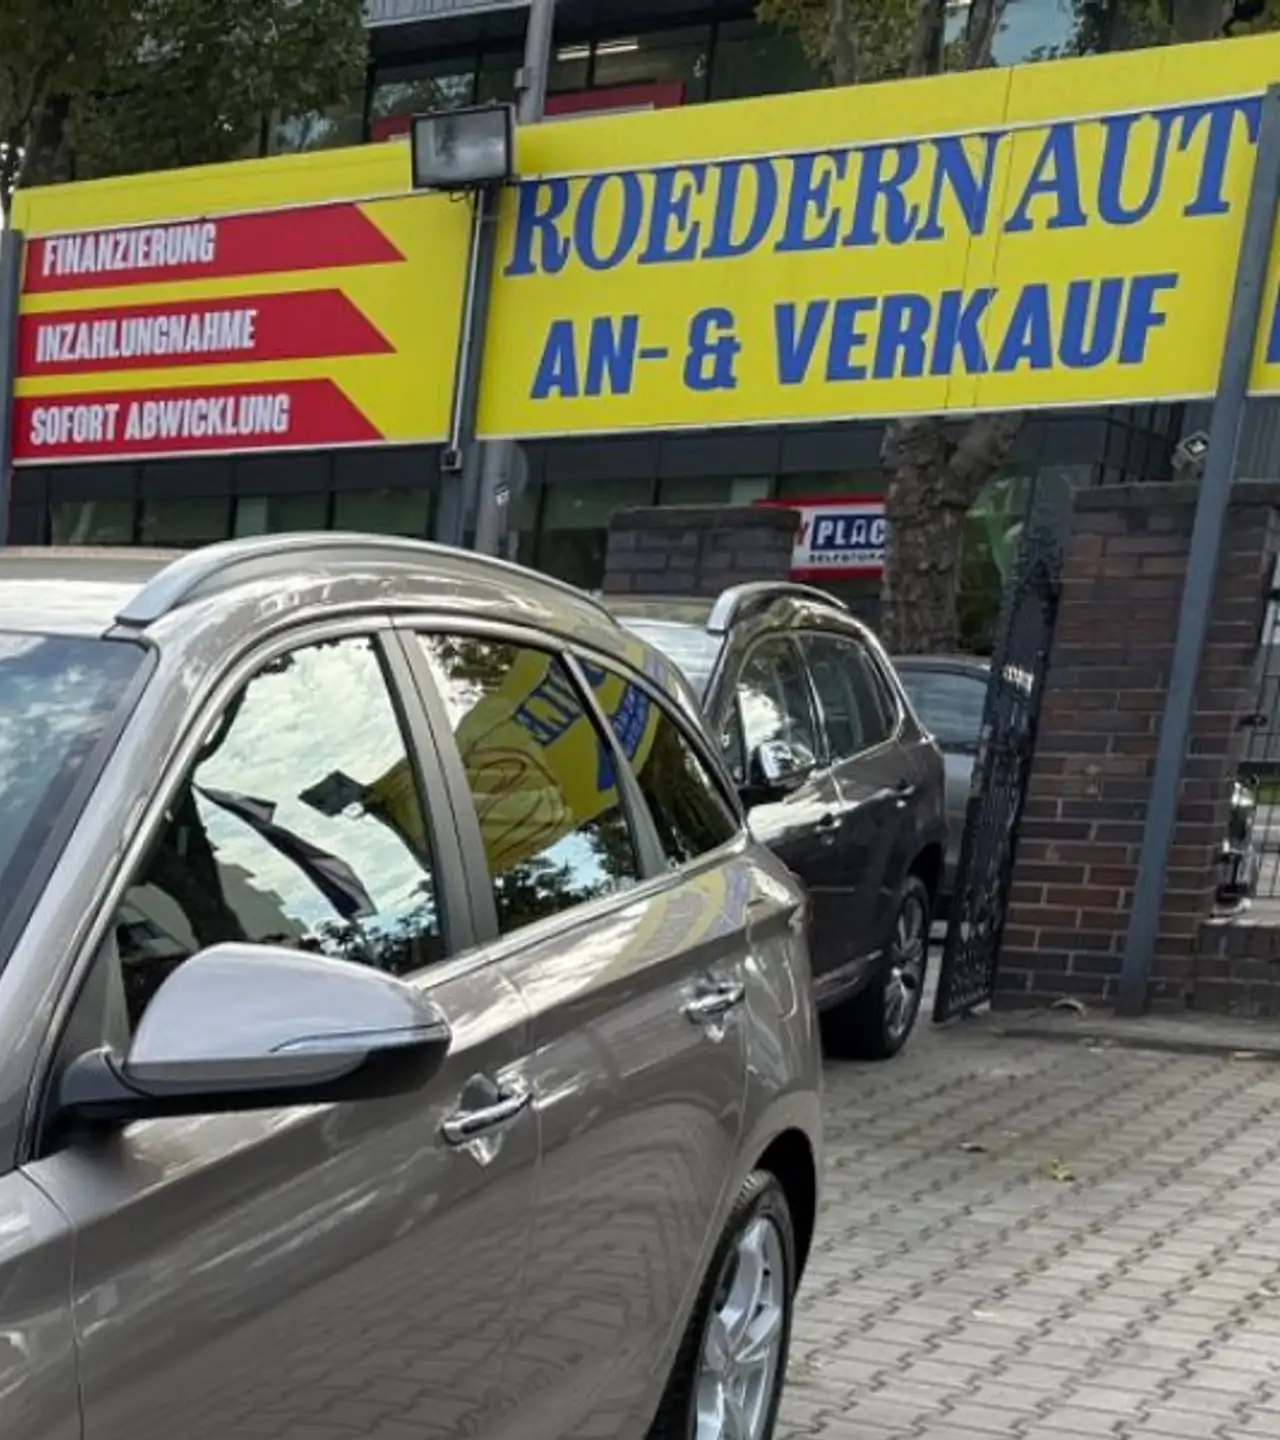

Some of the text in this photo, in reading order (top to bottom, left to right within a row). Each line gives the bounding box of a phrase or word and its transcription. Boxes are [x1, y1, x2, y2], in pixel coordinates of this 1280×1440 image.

[503, 130, 1012, 277] ROEDERN
[41, 222, 217, 277] FINANZIERUNG
[35, 308, 258, 363] INZAHLUNGNAHME
[530, 272, 1180, 400] AN- & VERKAUF
[29, 393, 291, 446] SOFORT ABWICKLUNG
[808, 552, 884, 563] SELFSTORA
[816, 518, 886, 547] PLAC
